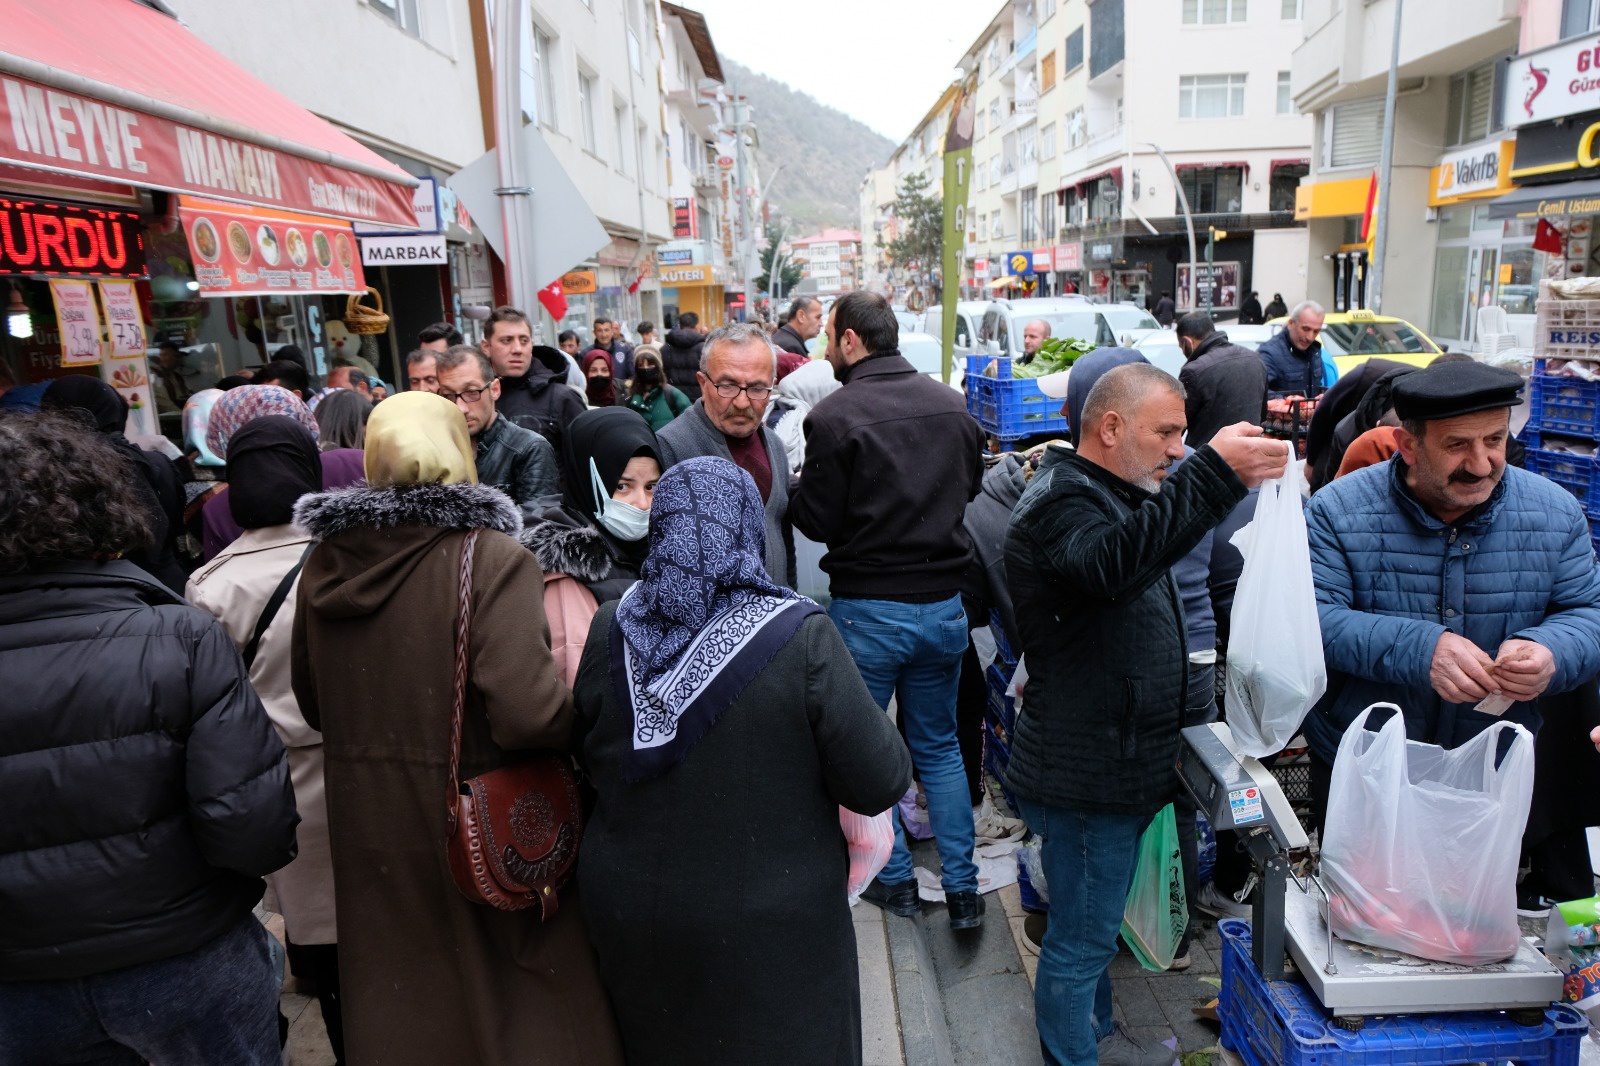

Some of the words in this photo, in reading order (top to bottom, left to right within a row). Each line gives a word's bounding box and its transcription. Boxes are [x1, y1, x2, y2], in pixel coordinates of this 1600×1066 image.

[2, 78, 148, 174] MEYVE
[175, 125, 282, 200] MANAVI
[1537, 200, 1566, 216] Cemil
[0, 199, 126, 270] ÜRDÜ
[368, 245, 443, 260] MARBAK
